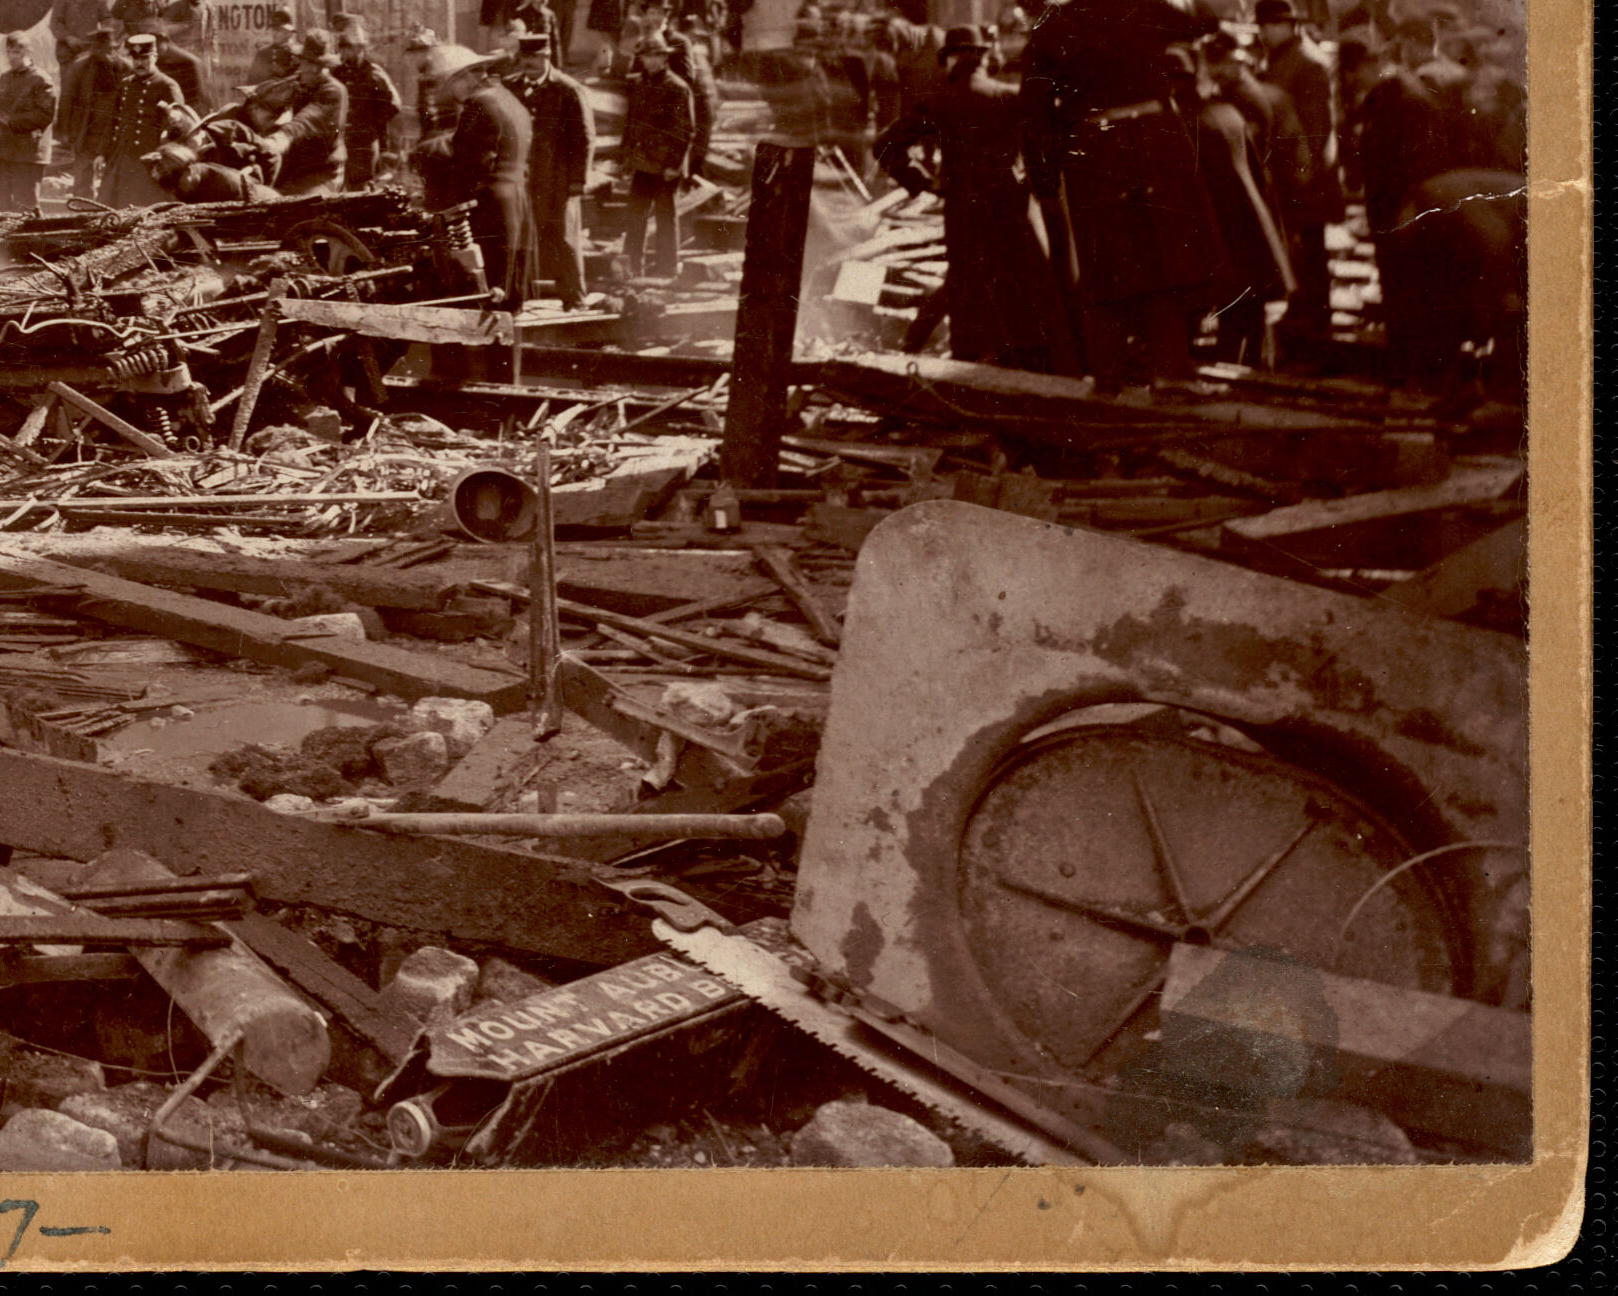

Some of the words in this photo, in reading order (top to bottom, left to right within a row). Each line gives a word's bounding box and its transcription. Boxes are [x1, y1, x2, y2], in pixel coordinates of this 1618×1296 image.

[218, 3, 277, 32] NGTON
[445, 991, 582, 1053] MOUNT
[487, 989, 687, 1072] HARVARD
